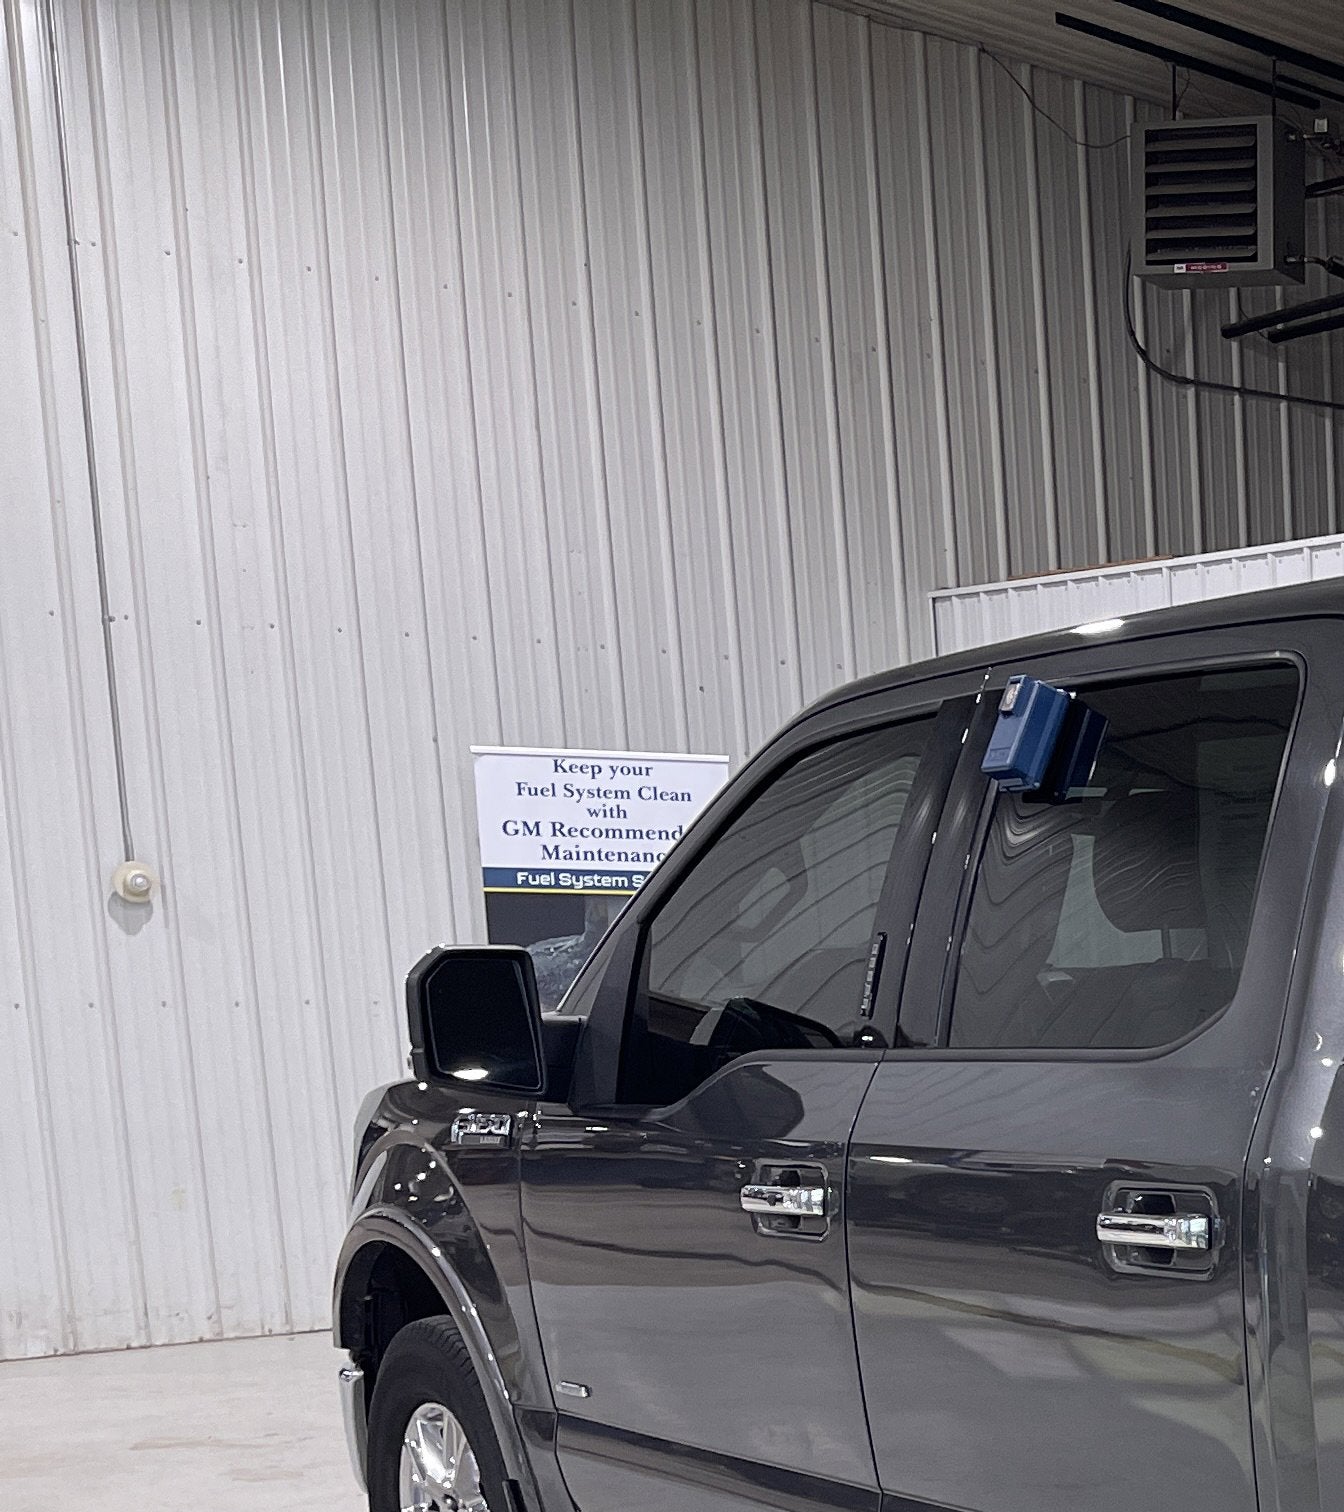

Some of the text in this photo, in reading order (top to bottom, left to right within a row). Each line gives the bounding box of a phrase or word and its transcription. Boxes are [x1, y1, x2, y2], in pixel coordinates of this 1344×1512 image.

[552, 758, 654, 780] Keep your
[516, 781, 693, 803] Fuel System Clean
[587, 804, 628, 819] with
[501, 819, 542, 838] GM
[516, 871, 555, 886] Fuel
[559, 872, 629, 890] System
